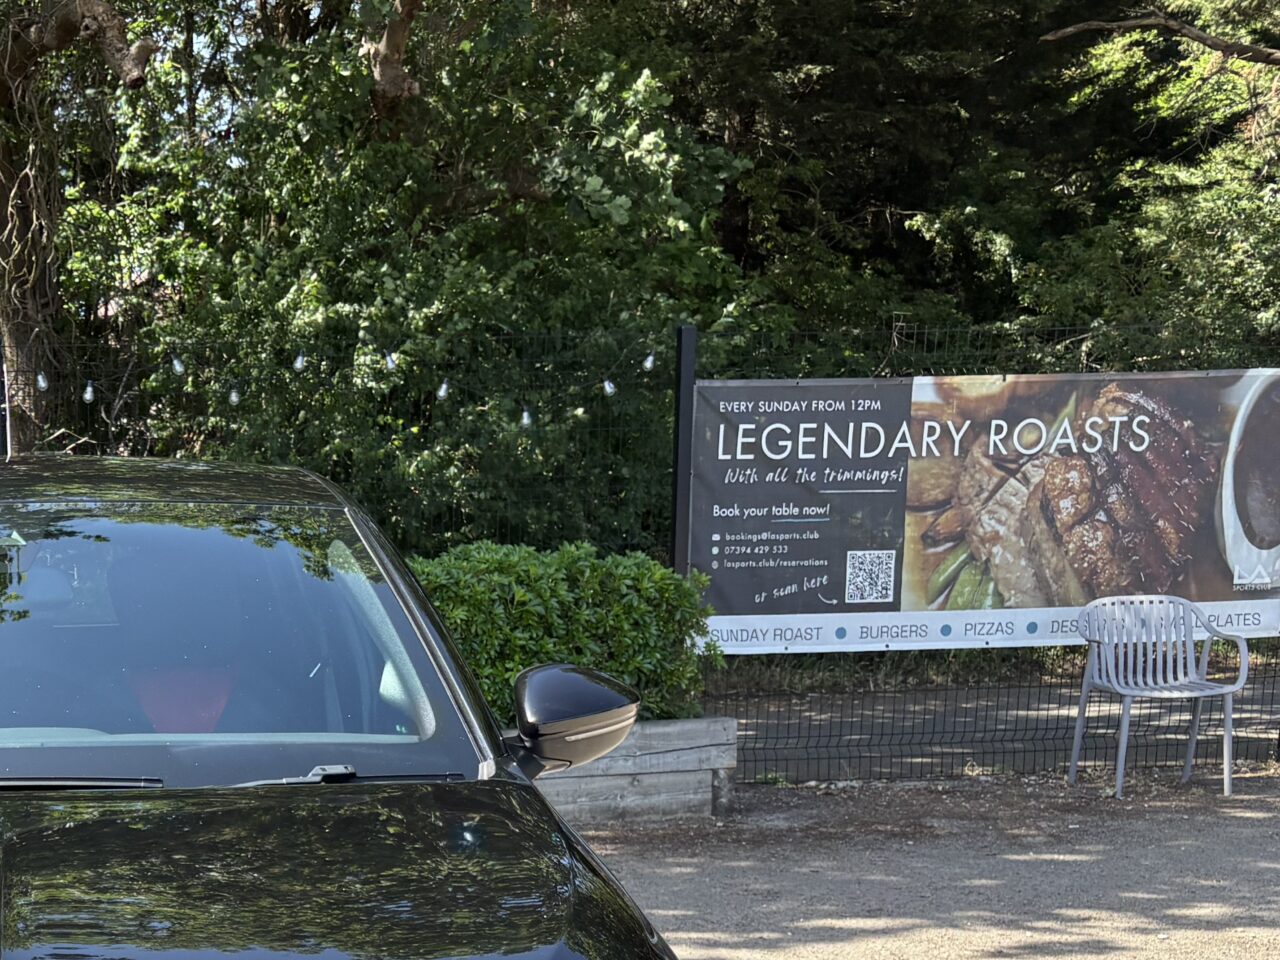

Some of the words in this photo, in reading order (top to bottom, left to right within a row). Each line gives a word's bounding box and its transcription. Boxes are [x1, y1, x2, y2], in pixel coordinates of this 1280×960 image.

[719, 402, 754, 413] EVERY
[758, 401, 807, 412] SUNDAY
[811, 400, 846, 411] FROM
[851, 400, 881, 411] 12PM
[718, 420, 972, 460] LEGENDARY
[988, 415, 1150, 456] ROASTS
[724, 468, 758, 484] With
[765, 467, 789, 482] all
[795, 467, 817, 483] the
[823, 467, 904, 485] trimmings!
[713, 504, 740, 517] Book
[743, 507, 769, 519] your
[772, 503, 799, 516] table
[803, 504, 830, 515] now!
[724, 546, 751, 555] 07394
[753, 545, 770, 554] 429
[772, 545, 789, 554] 533
[754, 592, 767, 603] or
[772, 584, 798, 599] scan
[803, 575, 828, 591] here
[710, 628, 769, 642] SUNDAY
[773, 627, 823, 641] ROAST
[859, 624, 928, 640] BURGERS
[964, 621, 1014, 636] PIZZAS
[1208, 612, 1261, 628] PLATES
